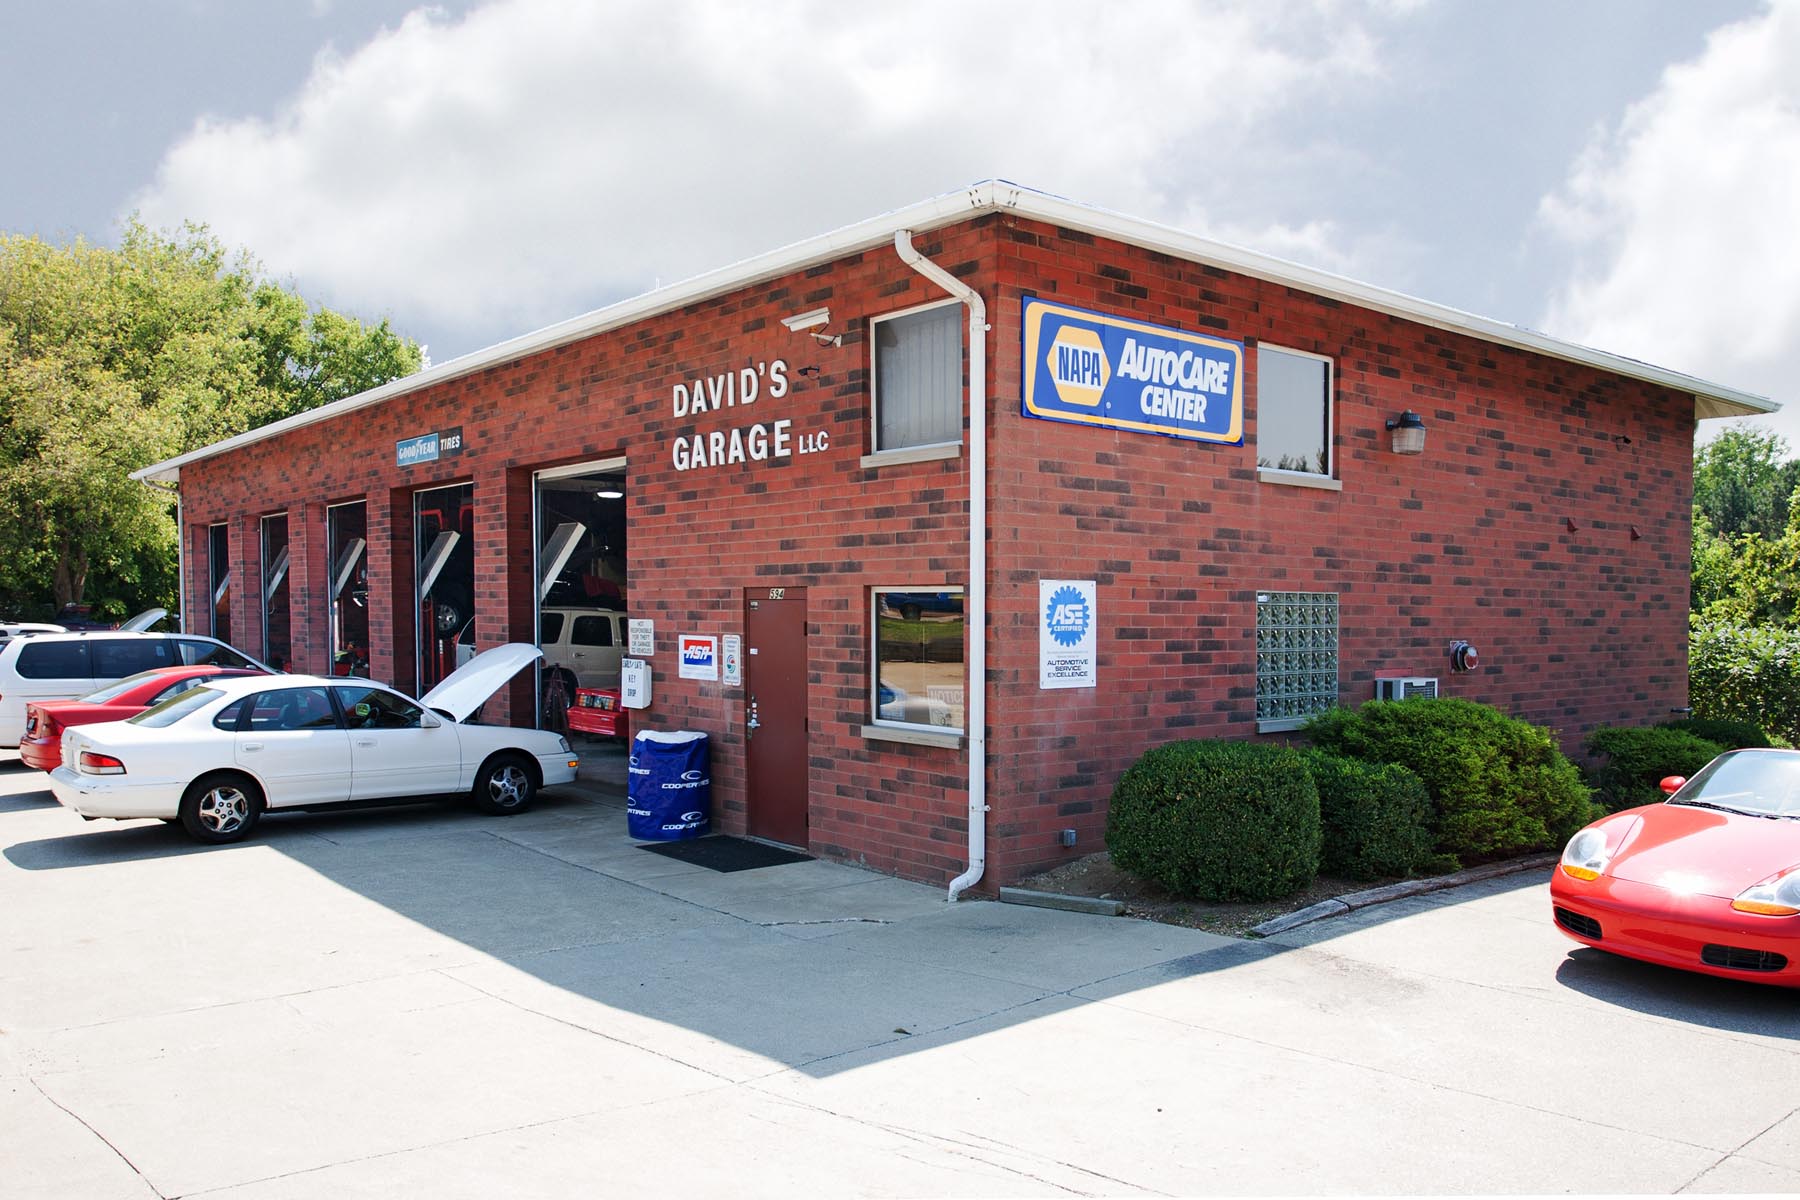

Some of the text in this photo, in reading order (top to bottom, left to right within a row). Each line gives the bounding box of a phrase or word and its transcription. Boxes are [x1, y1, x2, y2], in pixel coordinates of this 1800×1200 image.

[1058, 345, 1102, 387] NAPA
[673, 359, 788, 418] DAVID'S
[1140, 385, 1207, 423] CENTER
[399, 435, 460, 459] GOODYEAR TIRES
[672, 419, 829, 471] GARAGE LLC
[770, 589, 784, 599] 594
[1051, 604, 1084, 625] ASE
[686, 645, 711, 660] ASA
